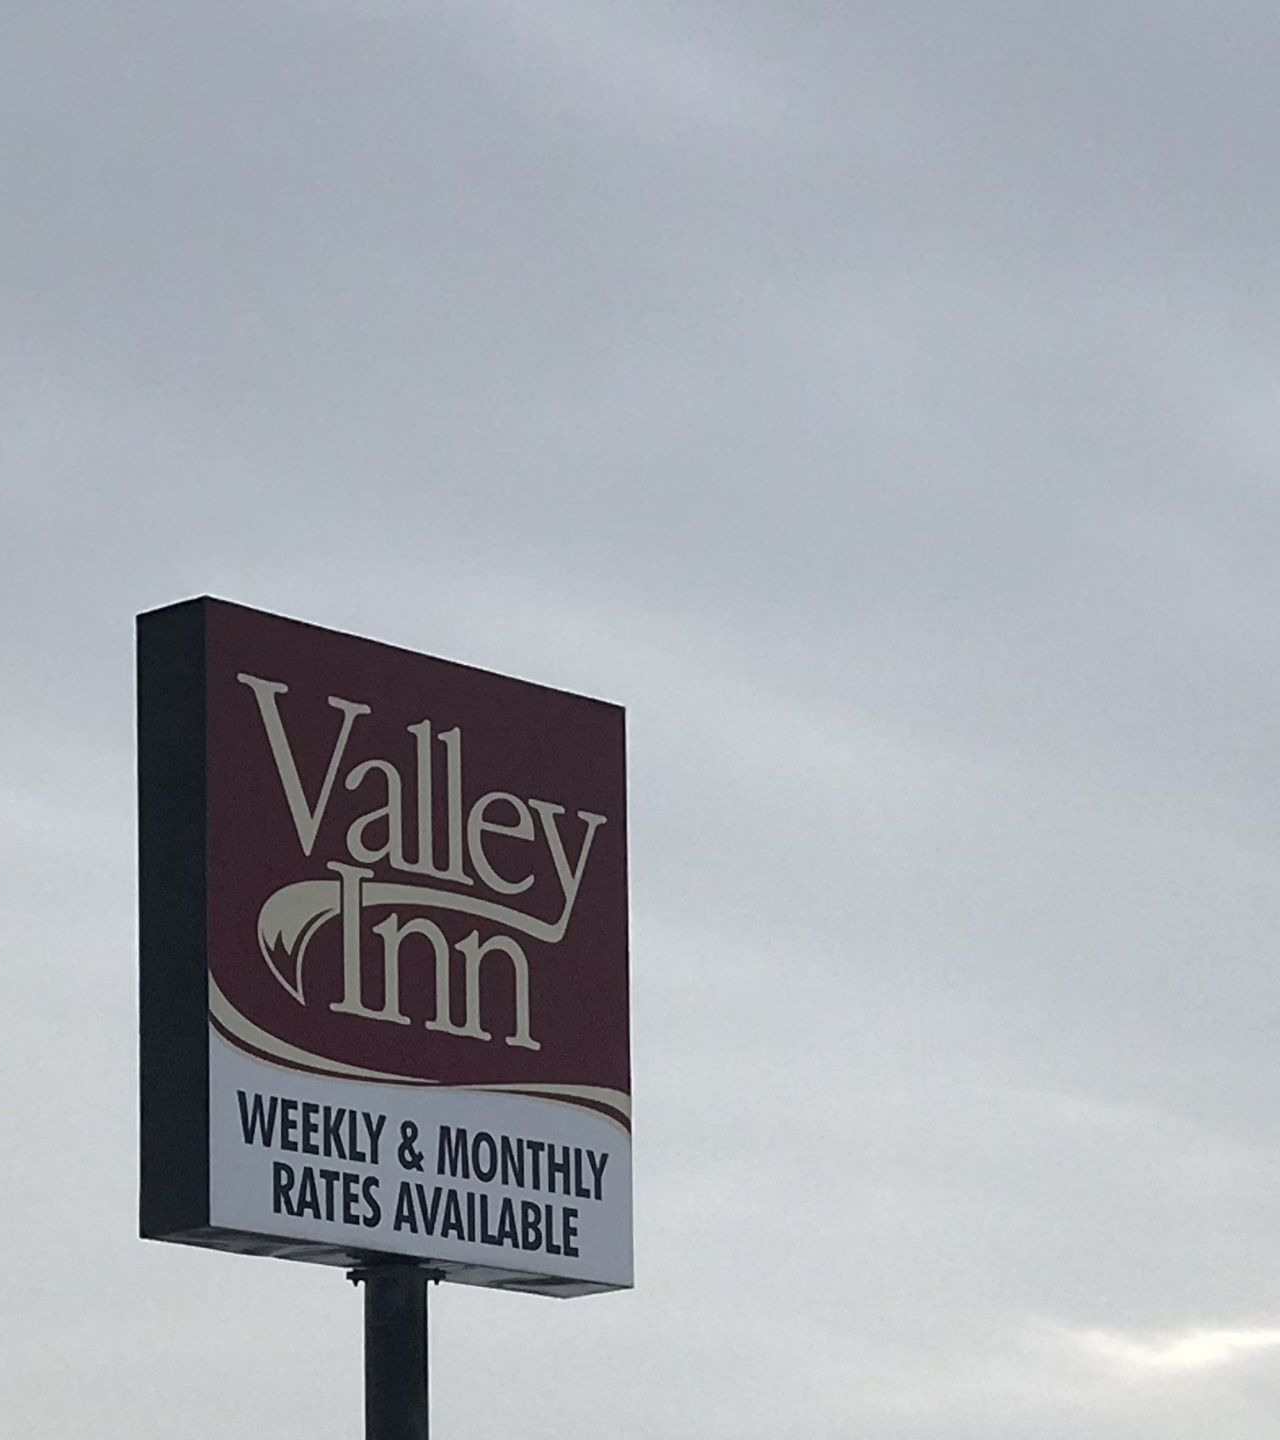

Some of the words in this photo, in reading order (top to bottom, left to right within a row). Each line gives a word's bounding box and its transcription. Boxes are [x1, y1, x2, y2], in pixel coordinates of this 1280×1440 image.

[237, 673, 608, 943] Valley
[326, 861, 542, 1051] Inn
[236, 1089, 388, 1166] WEEKLY
[397, 1120, 425, 1173] &
[436, 1124, 609, 1201] MONTHLY
[272, 1160, 382, 1230] RATES
[392, 1180, 581, 1259] AVAILABLE
